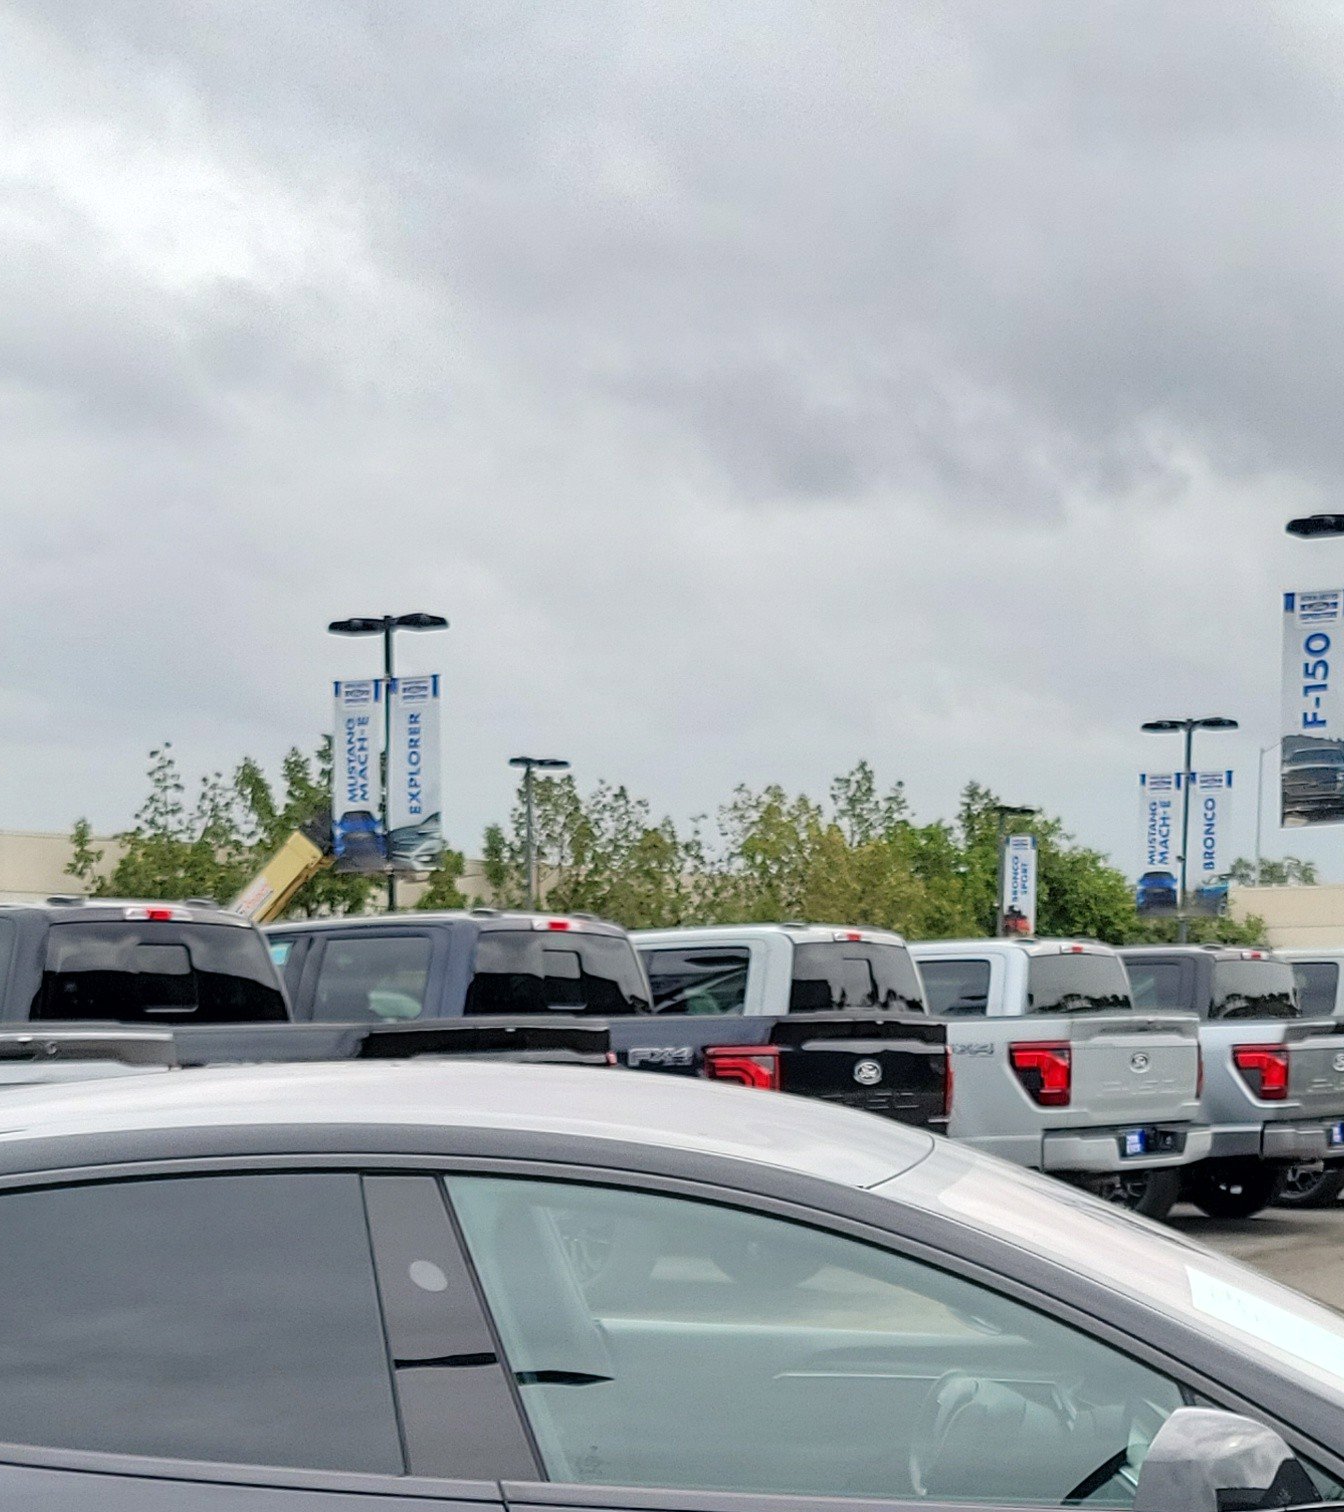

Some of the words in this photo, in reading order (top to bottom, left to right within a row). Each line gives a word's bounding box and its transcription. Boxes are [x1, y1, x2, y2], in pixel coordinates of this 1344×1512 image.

[1303, 633, 1330, 729] F-150
[346, 718, 356, 802] MUSTANG
[357, 716, 369, 802] MACH-E
[408, 713, 421, 815] EXPLORER
[1203, 798, 1216, 870] BRONCO
